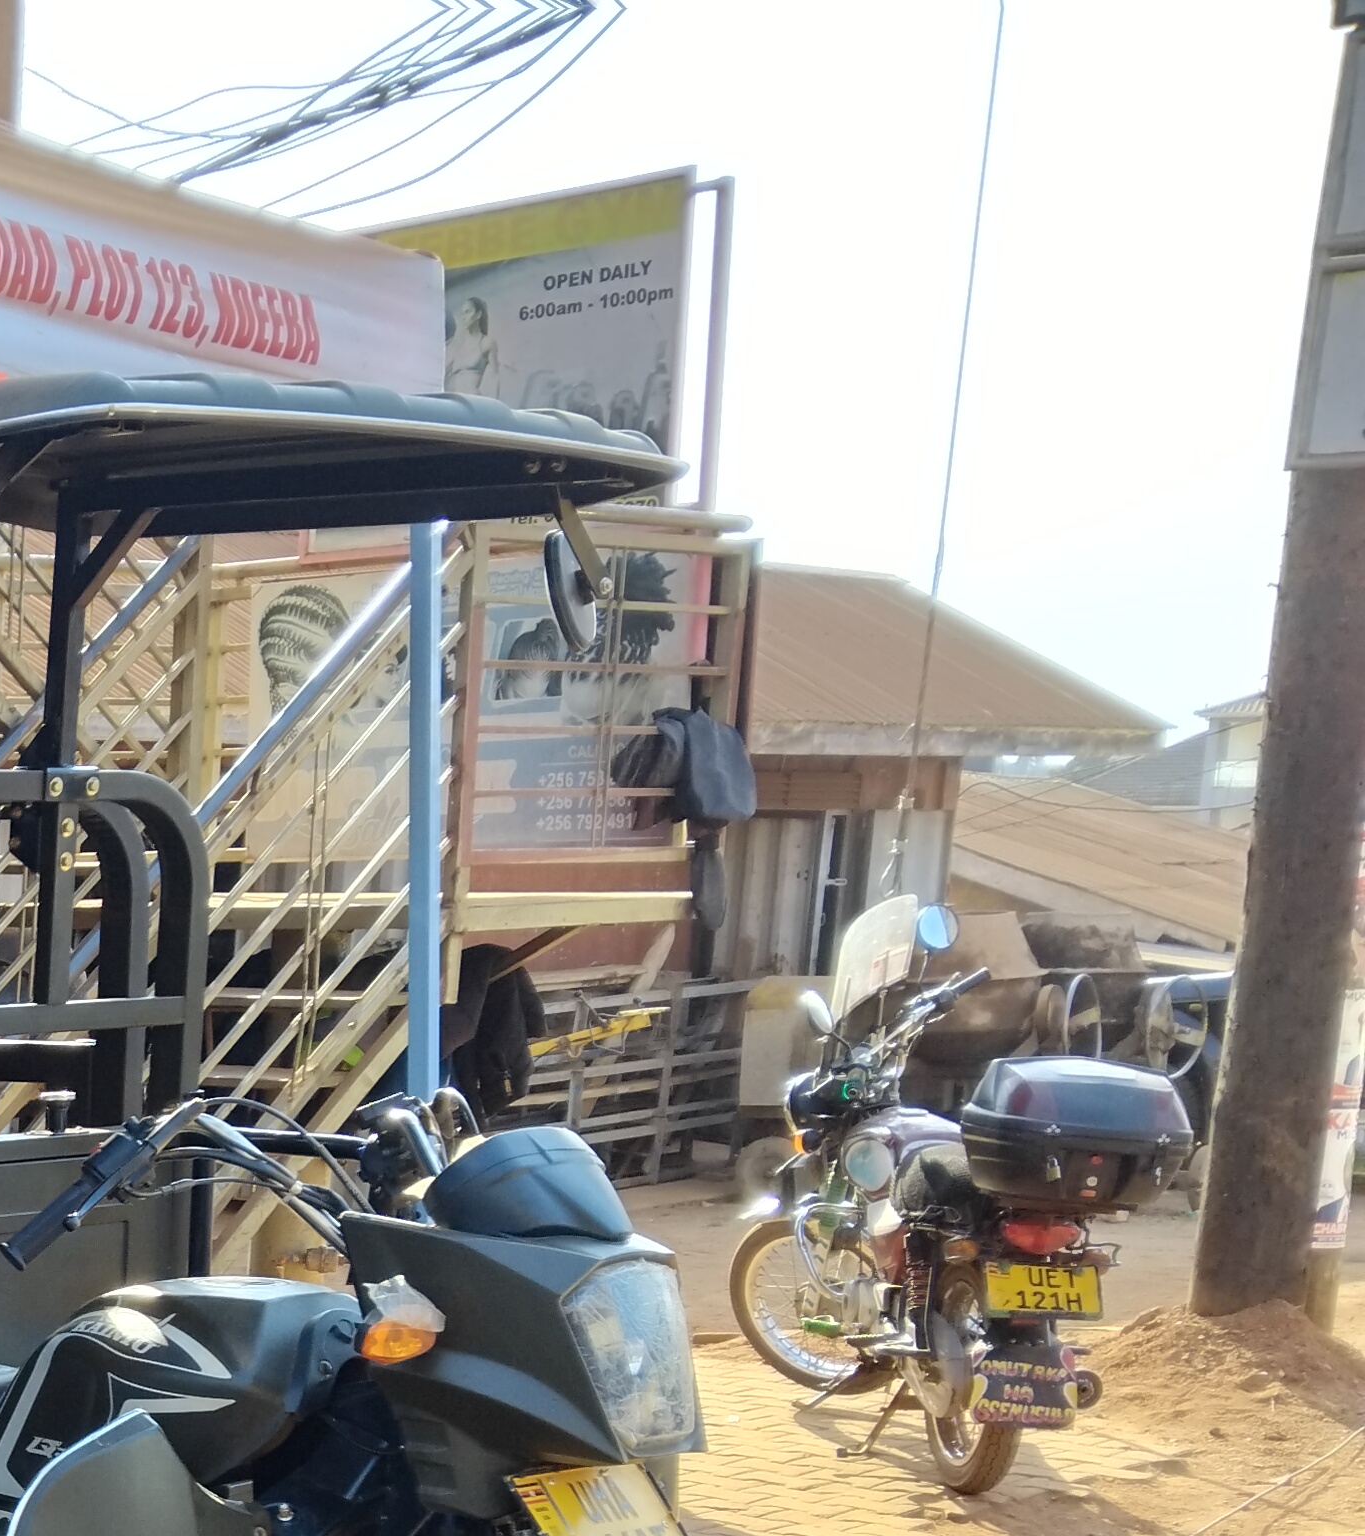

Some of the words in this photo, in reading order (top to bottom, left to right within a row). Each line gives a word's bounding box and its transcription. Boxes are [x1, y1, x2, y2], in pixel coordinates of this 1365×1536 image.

[543, 269, 593, 291] OPEN
[600, 260, 653, 282] DAILY
[64, 235, 145, 322] PLOT
[145, 257, 210, 349] 123,
[211, 272, 321, 366] NDEEBA
[519, 300, 583, 321] 6:00am
[600, 286, 674, 309] 10:00pm
[538, 771, 574, 788] +256
[536, 814, 572, 831] +256
[1016, 1290, 1083, 1312] 121H
[567, 1475, 640, 1524] UMA
